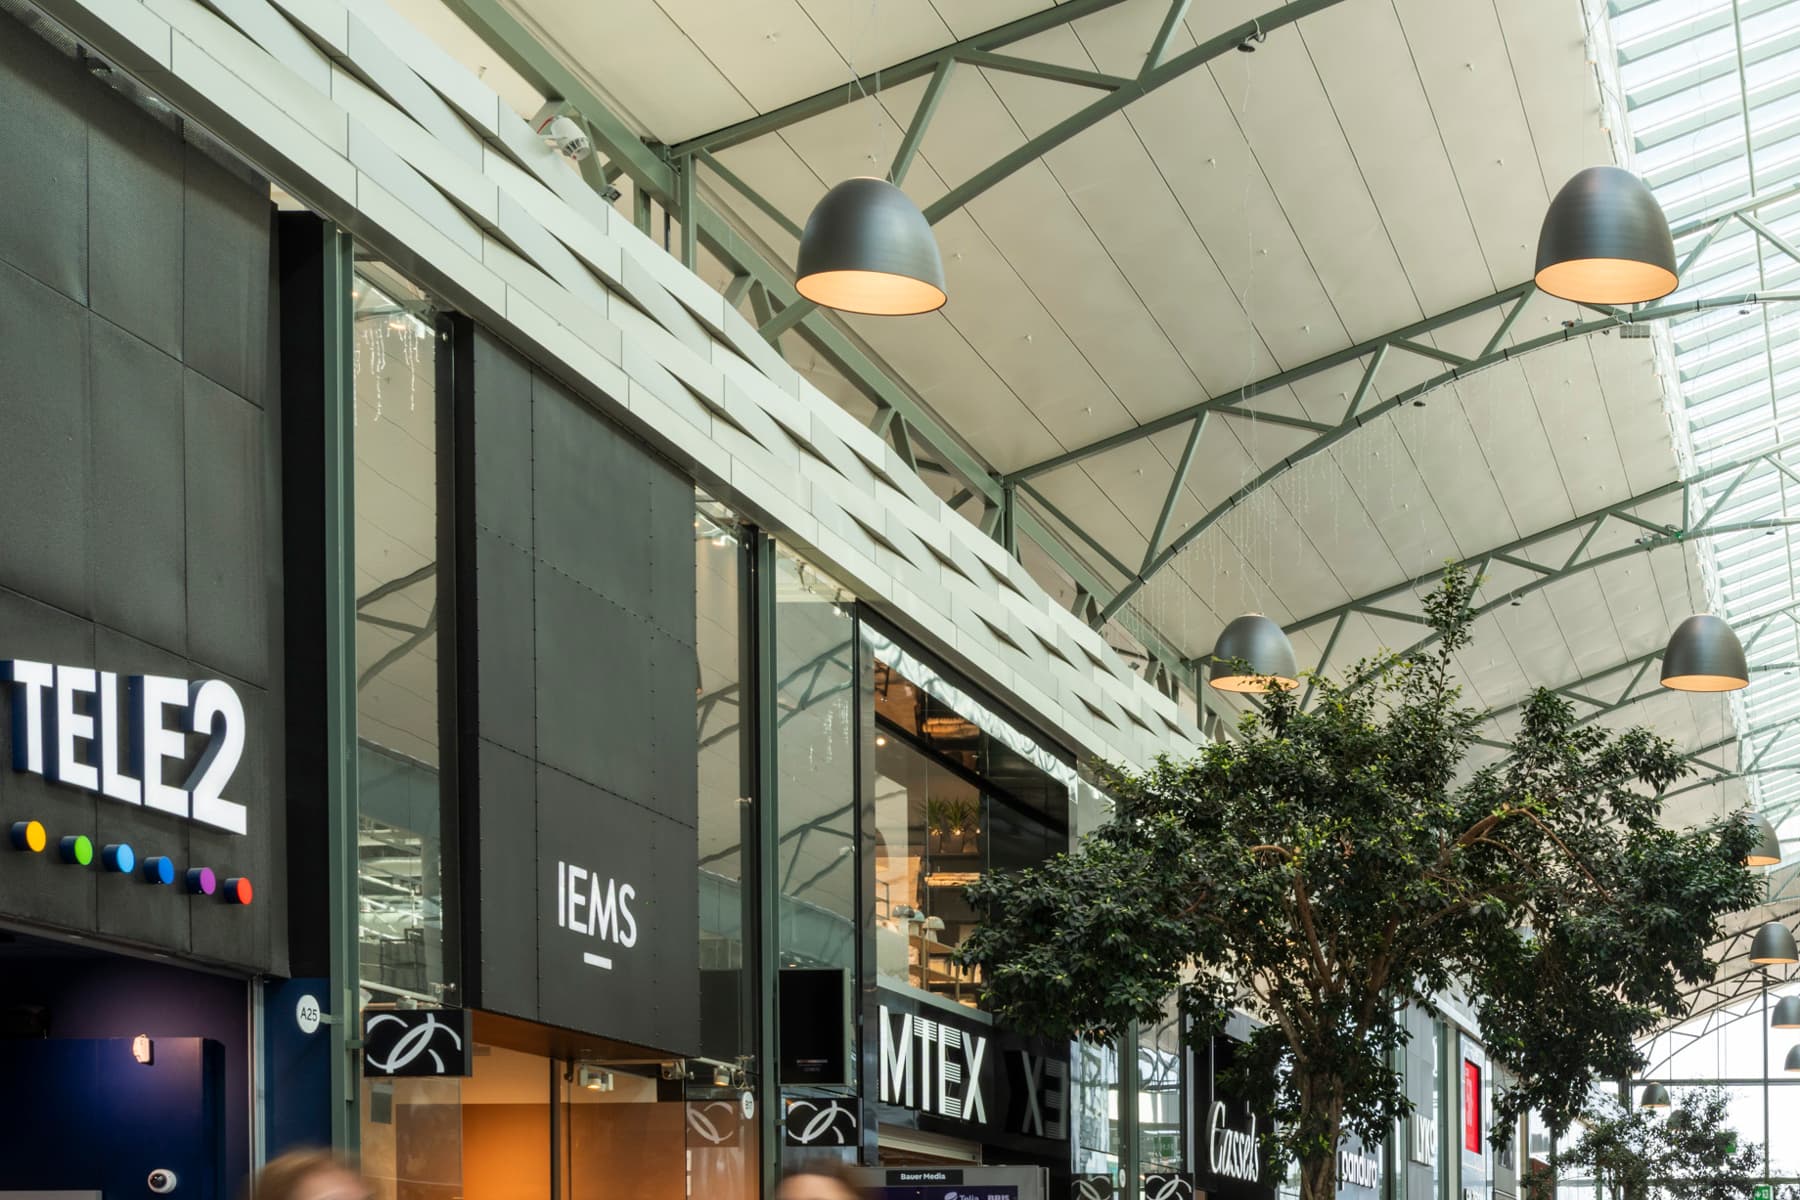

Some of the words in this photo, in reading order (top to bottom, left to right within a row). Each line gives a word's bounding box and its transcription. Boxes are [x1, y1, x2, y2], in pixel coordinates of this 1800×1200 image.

[13, 658, 247, 836] TELE2
[557, 860, 637, 948] IEMS
[300, 1007, 318, 1022] A25
[879, 1004, 987, 1125] MTEX
[900, 1173, 922, 1181] Bauer
[923, 1172, 946, 1181] Media
[1340, 1146, 1378, 1192] panduro
